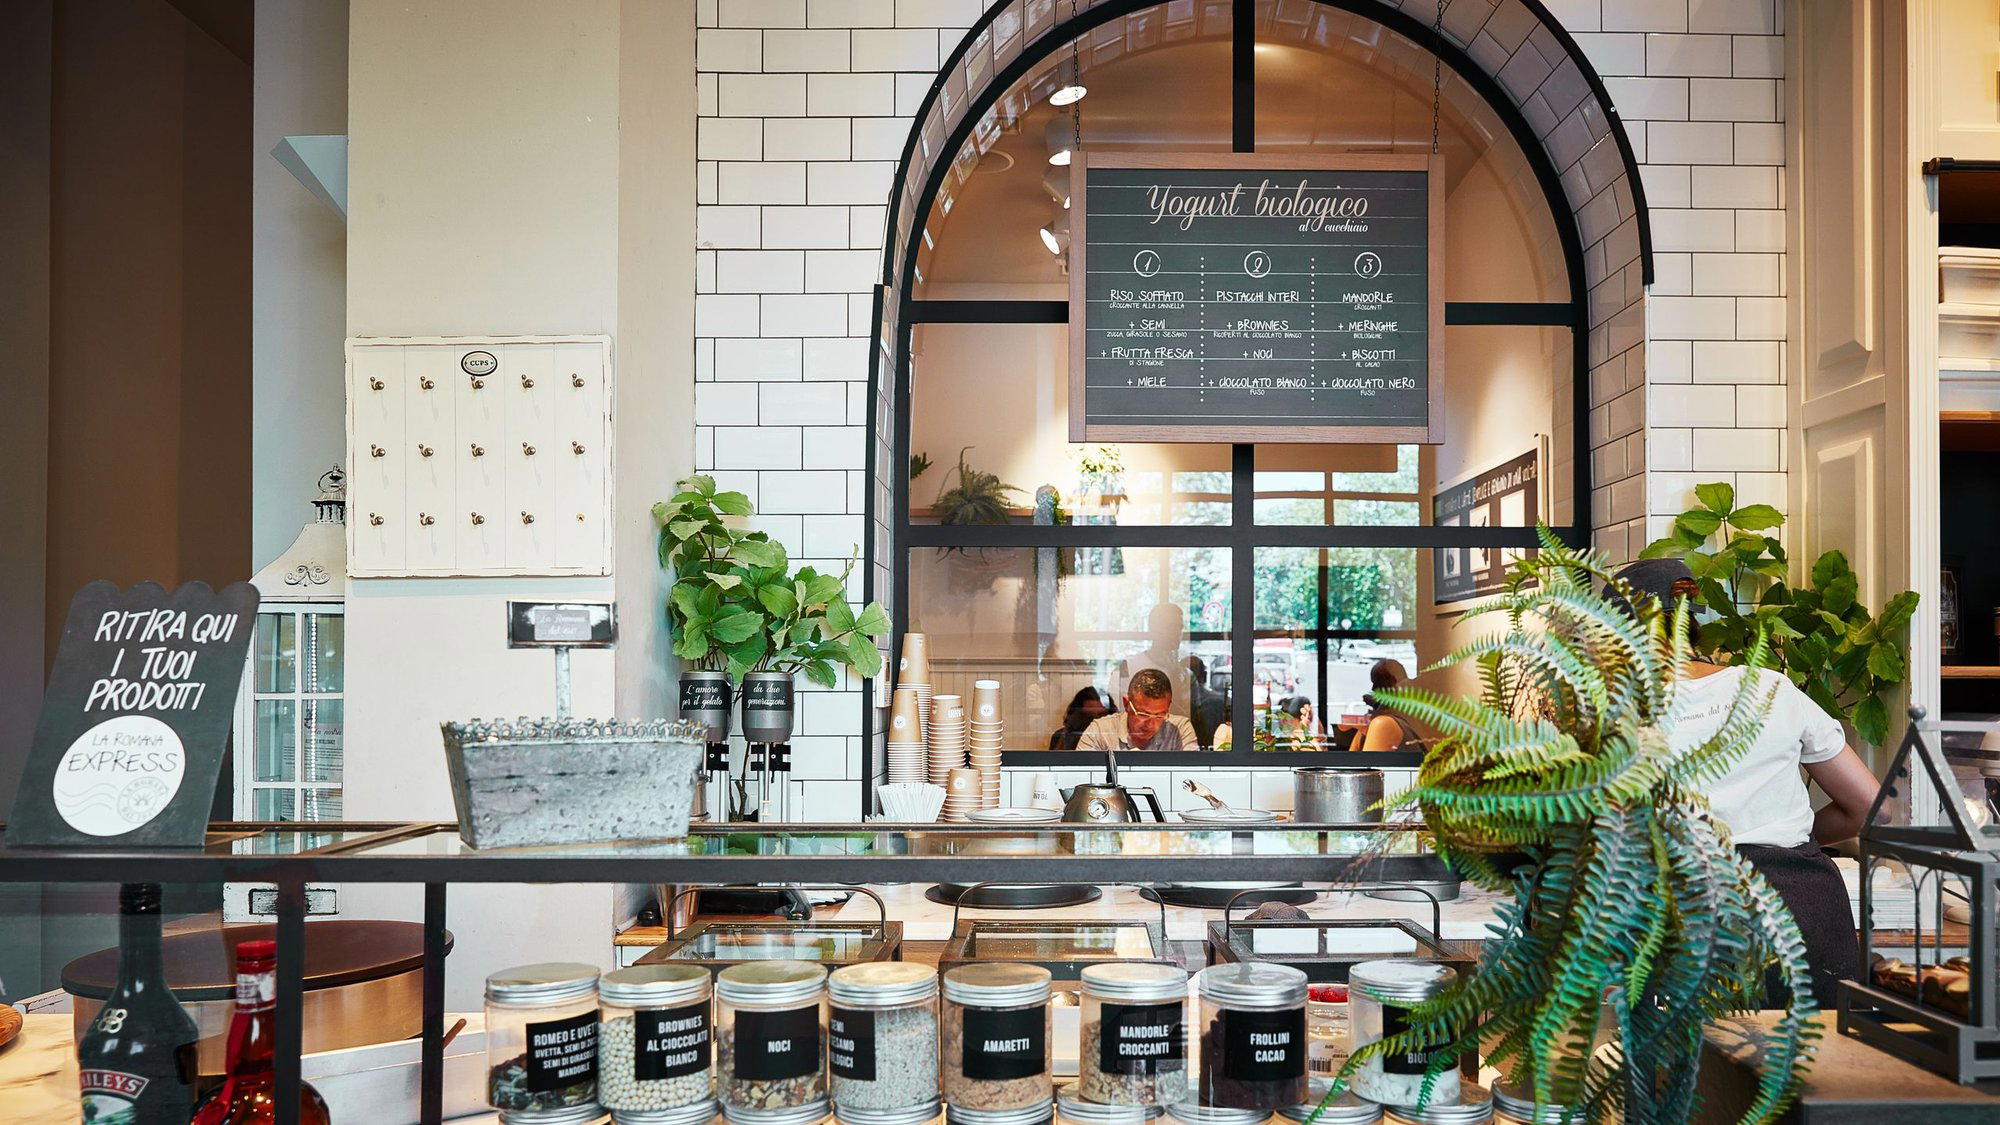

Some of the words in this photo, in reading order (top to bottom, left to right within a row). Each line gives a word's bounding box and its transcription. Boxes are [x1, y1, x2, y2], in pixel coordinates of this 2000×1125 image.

[1146, 184, 1246, 231] Yogurt
[1254, 178, 1368, 232] biologico
[1298, 219, 1310, 232] al
[1324, 219, 1369, 233] cucchiaio
[1252, 256, 1263, 273] 2
[1363, 257, 1374, 273] 3
[1110, 289, 1134, 301] RISO
[1138, 290, 1184, 301] SOFFIATO
[1216, 290, 1264, 302] PISTACCHI
[1267, 290, 1299, 302] INTERI
[1342, 290, 1394, 303] MANDORLE
[1140, 319, 1165, 330] SEMI
[1237, 318, 1289, 331] BROWNIES
[1348, 319, 1399, 332] MERINGHE
[1126, 330, 1154, 338] GIRASOLE
[1111, 346, 1151, 358] FRUTTA
[1154, 346, 1194, 358] FRESCA
[1252, 348, 1273, 359] NOCI
[1351, 348, 1396, 360] BISCOTTI
[1137, 375, 1167, 387] MIELE
[1218, 376, 1272, 388] CIOCCOLATO
[1276, 376, 1307, 388] BIANCO
[1331, 377, 1385, 389] CIOCCOLATO
[1388, 376, 1416, 389] NERO
[94, 608, 187, 643] RITIRA
[191, 613, 238, 644] QUI
[110, 648, 125, 677] I
[140, 647, 198, 680] TUOI
[753, 683, 764, 693] da
[766, 683, 781, 693] due
[83, 678, 206, 713] PRODOTTI
[693, 695, 700, 705] il
[701, 695, 723, 709] gelato
[1675, 711, 1705, 722] omana
[92, 732, 108, 747] LA
[113, 731, 164, 747] ROMANA
[68, 750, 178, 773] EXPRESS
[658, 1015, 703, 1034] BROWNIES
[534, 1030, 569, 1046] ROMEO
[570, 1028, 576, 1041] E
[1119, 1025, 1169, 1039] MANDORLE
[1250, 1032, 1290, 1045] FROLLINI
[564, 1042, 580, 1054] SEMI
[647, 1039, 660, 1052] AL
[767, 1039, 791, 1053] NOCI
[983, 1038, 1030, 1053] AMARETTI
[1119, 1042, 1170, 1056] CROCCANTI
[666, 1050, 698, 1067] BIANCO
[1255, 1049, 1286, 1062] CACAO
[543, 1058, 561, 1069] SEMI
[561, 1057, 569, 1066] DI
[558, 1061, 591, 1078] MANDORLE
